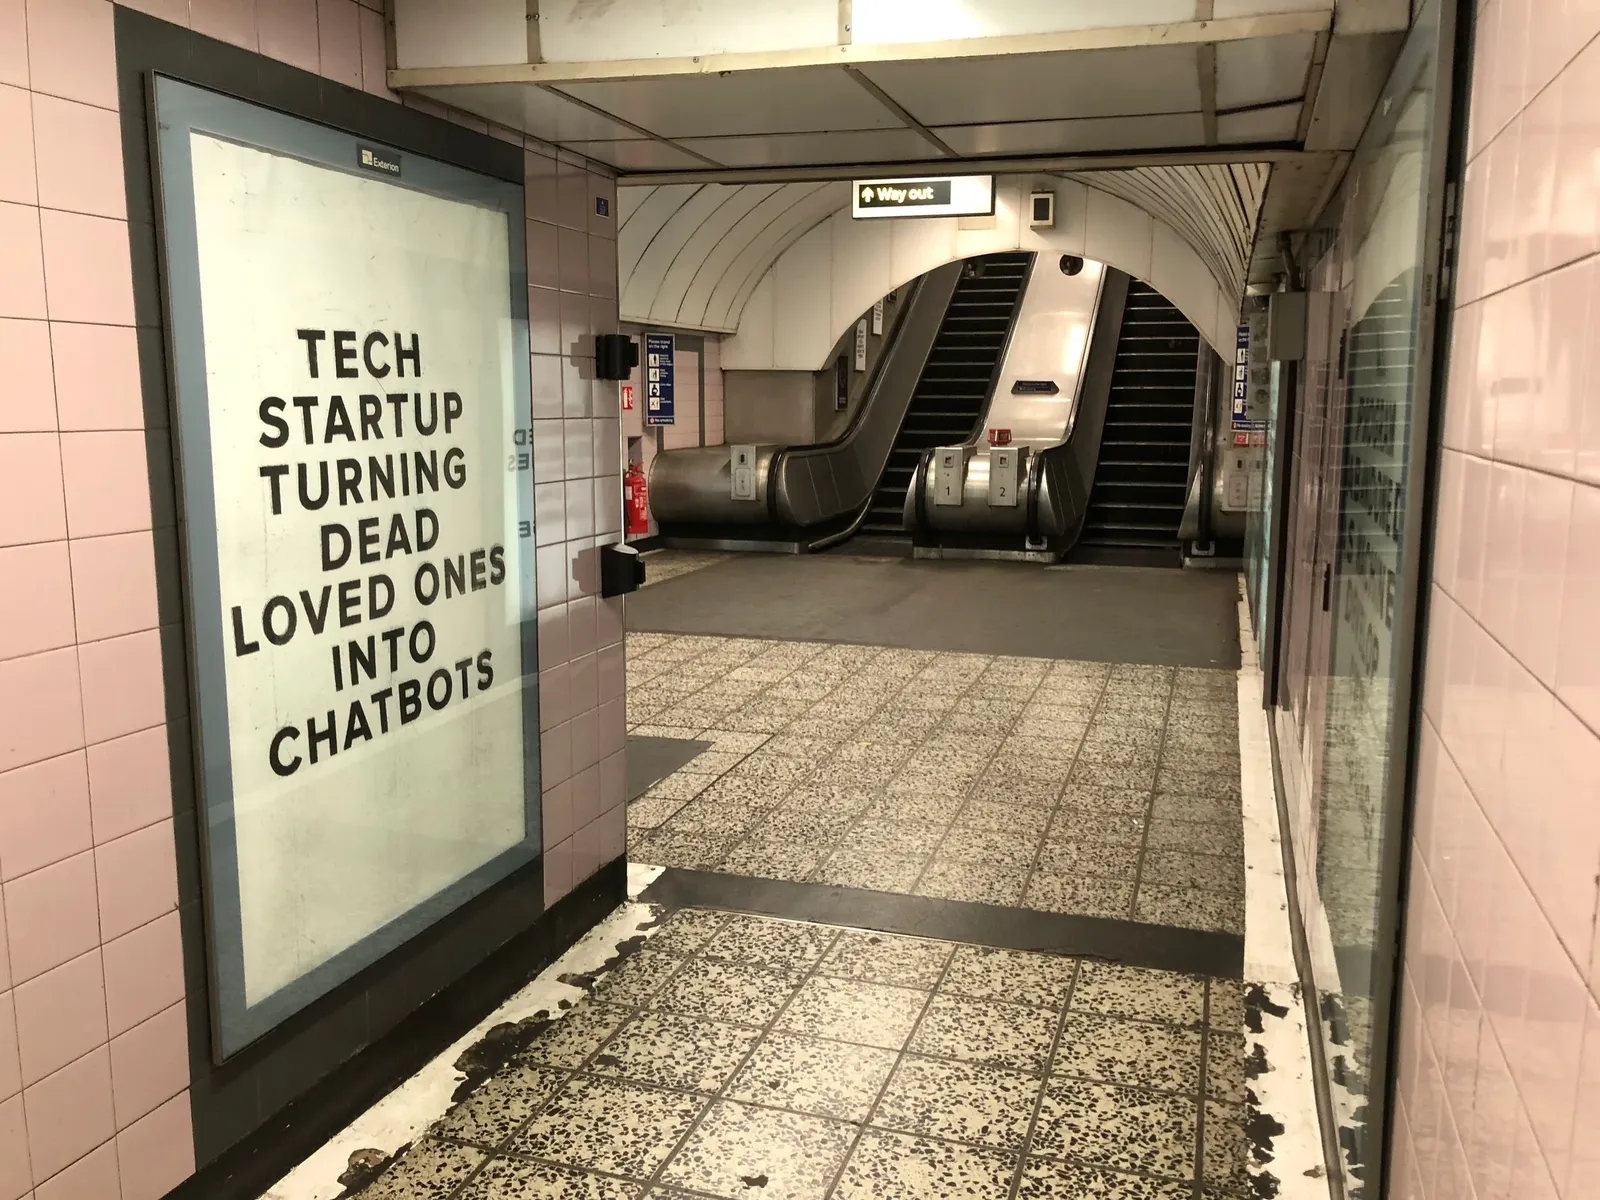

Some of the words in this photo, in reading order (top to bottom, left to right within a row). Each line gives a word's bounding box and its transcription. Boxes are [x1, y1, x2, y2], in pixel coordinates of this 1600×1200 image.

[373, 157, 400, 172] Exterion
[876, 187, 907, 203] Way
[908, 187, 934, 200] out
[296, 329, 422, 379] TECH
[258, 392, 463, 449] STARTUP
[259, 447, 467, 516] TURNING
[946, 486, 950, 496] 1
[1000, 487, 1006, 497] 2
[320, 508, 440, 572] DEAD
[231, 573, 396, 657] LOVED
[414, 545, 506, 606] ONES
[331, 620, 436, 692] INTO
[269, 649, 494, 777] CHATBOTS
